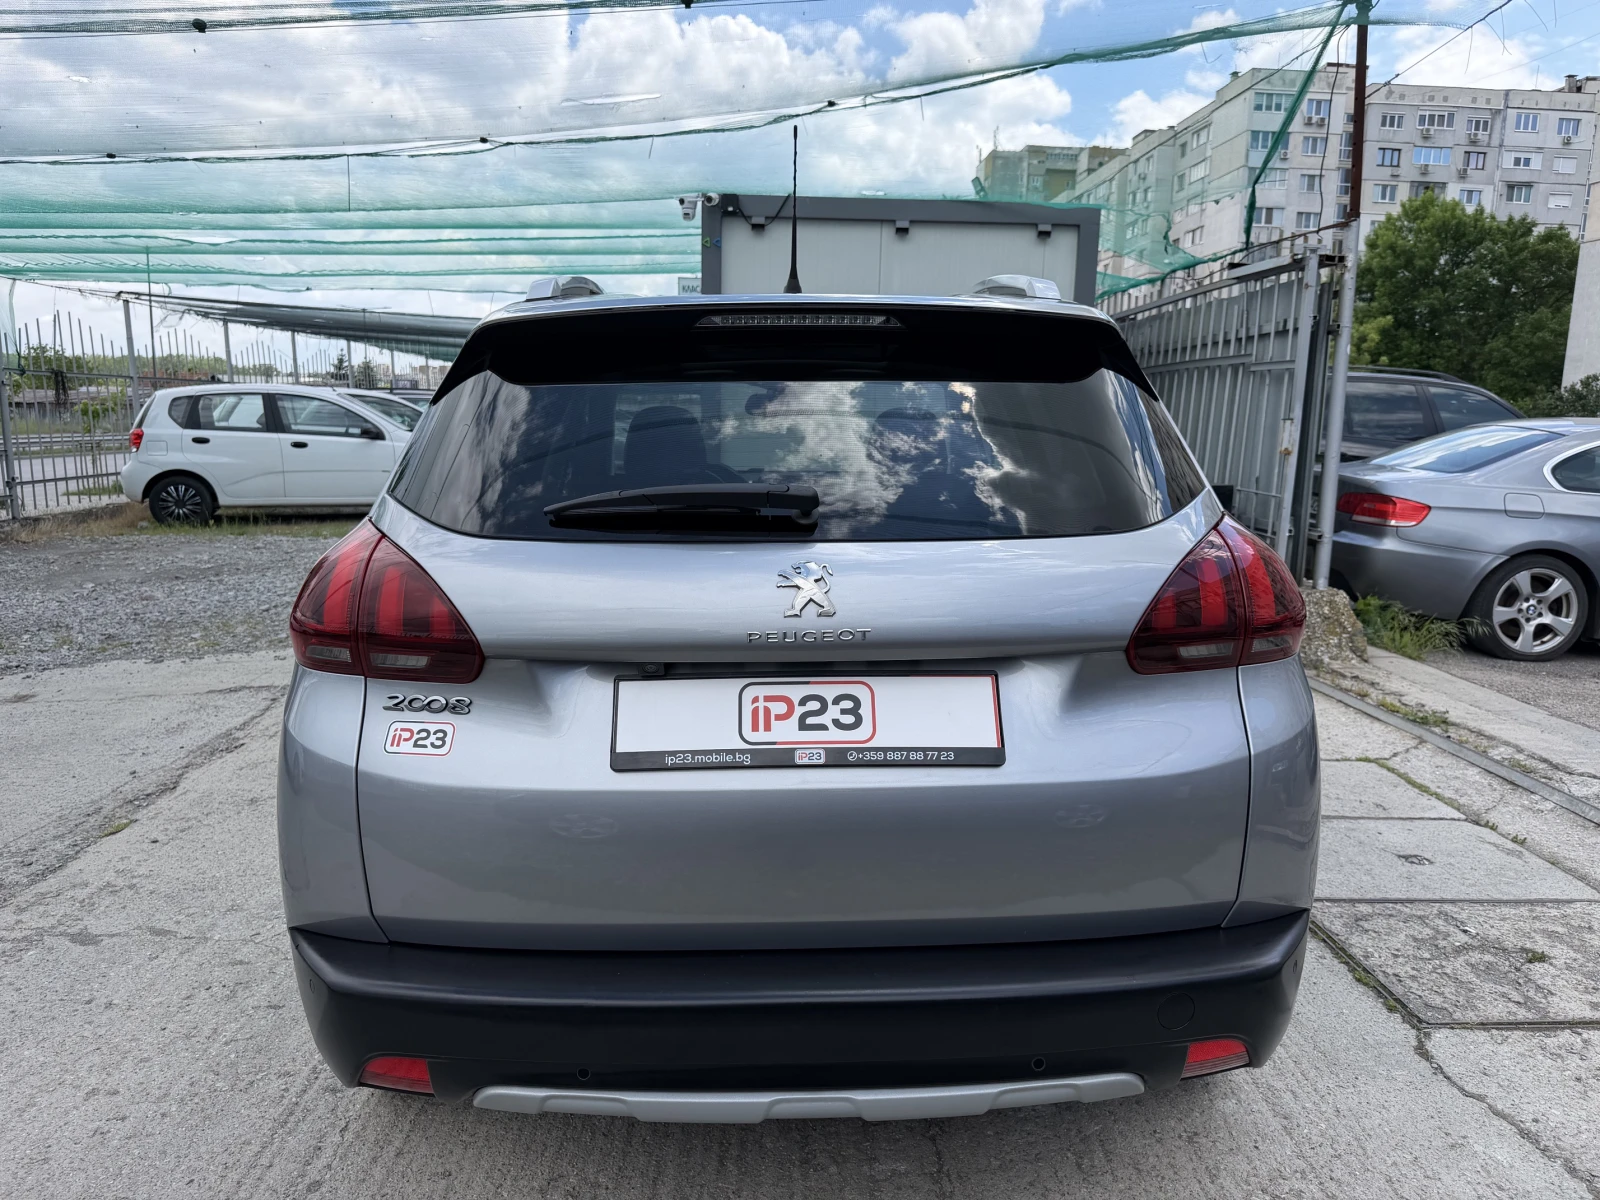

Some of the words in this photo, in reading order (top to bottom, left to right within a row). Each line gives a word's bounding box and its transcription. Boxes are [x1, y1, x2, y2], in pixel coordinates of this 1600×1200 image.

[747, 628, 872, 643] PEUGEOT
[382, 693, 472, 715] 2008
[665, 752, 751, 766] ip23.mobile.bg
[886, 751, 907, 760] 887
[909, 751, 924, 760] 88
[926, 751, 938, 760] 77
[940, 751, 954, 760] 23
